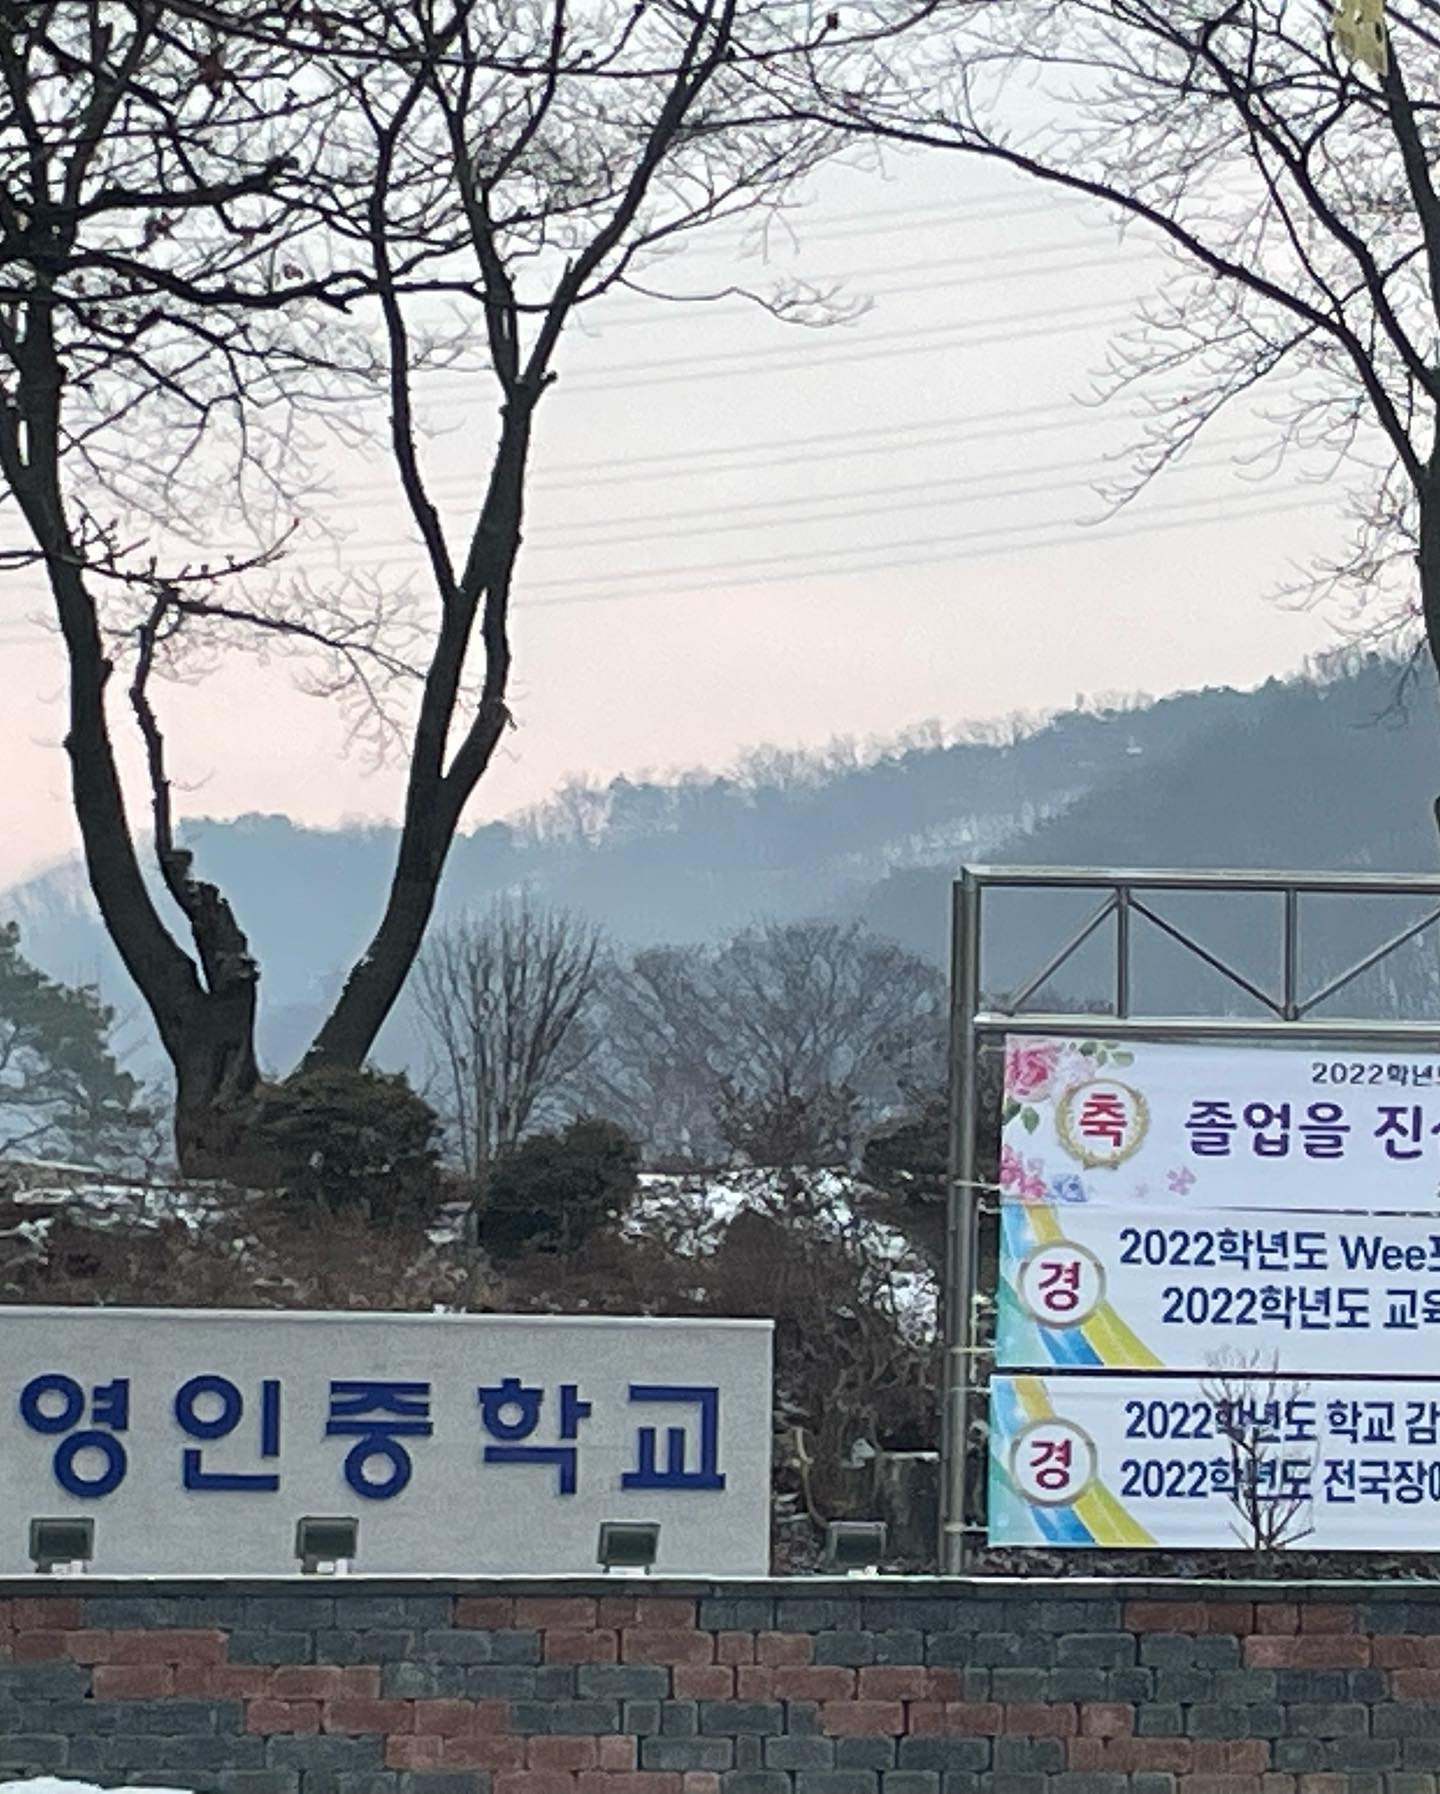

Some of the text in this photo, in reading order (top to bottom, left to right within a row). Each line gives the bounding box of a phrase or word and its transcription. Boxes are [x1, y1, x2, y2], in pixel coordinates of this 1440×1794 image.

[1312, 1062, 1440, 1087] 2022학년
[1079, 1092, 1128, 1148] 축
[1184, 1100, 1440, 1160] 졸업을 진
[1119, 1227, 1328, 1271] 2022학년도
[1038, 1260, 1082, 1312] 경
[1162, 1284, 1370, 1331] 2022학년도
[20, 1373, 726, 1500] 영인중학교
[1124, 1399, 1440, 1444] 2022학년도 학교 감
[1029, 1438, 1073, 1490] 경
[1120, 1456, 1313, 1502] 2022학년도
